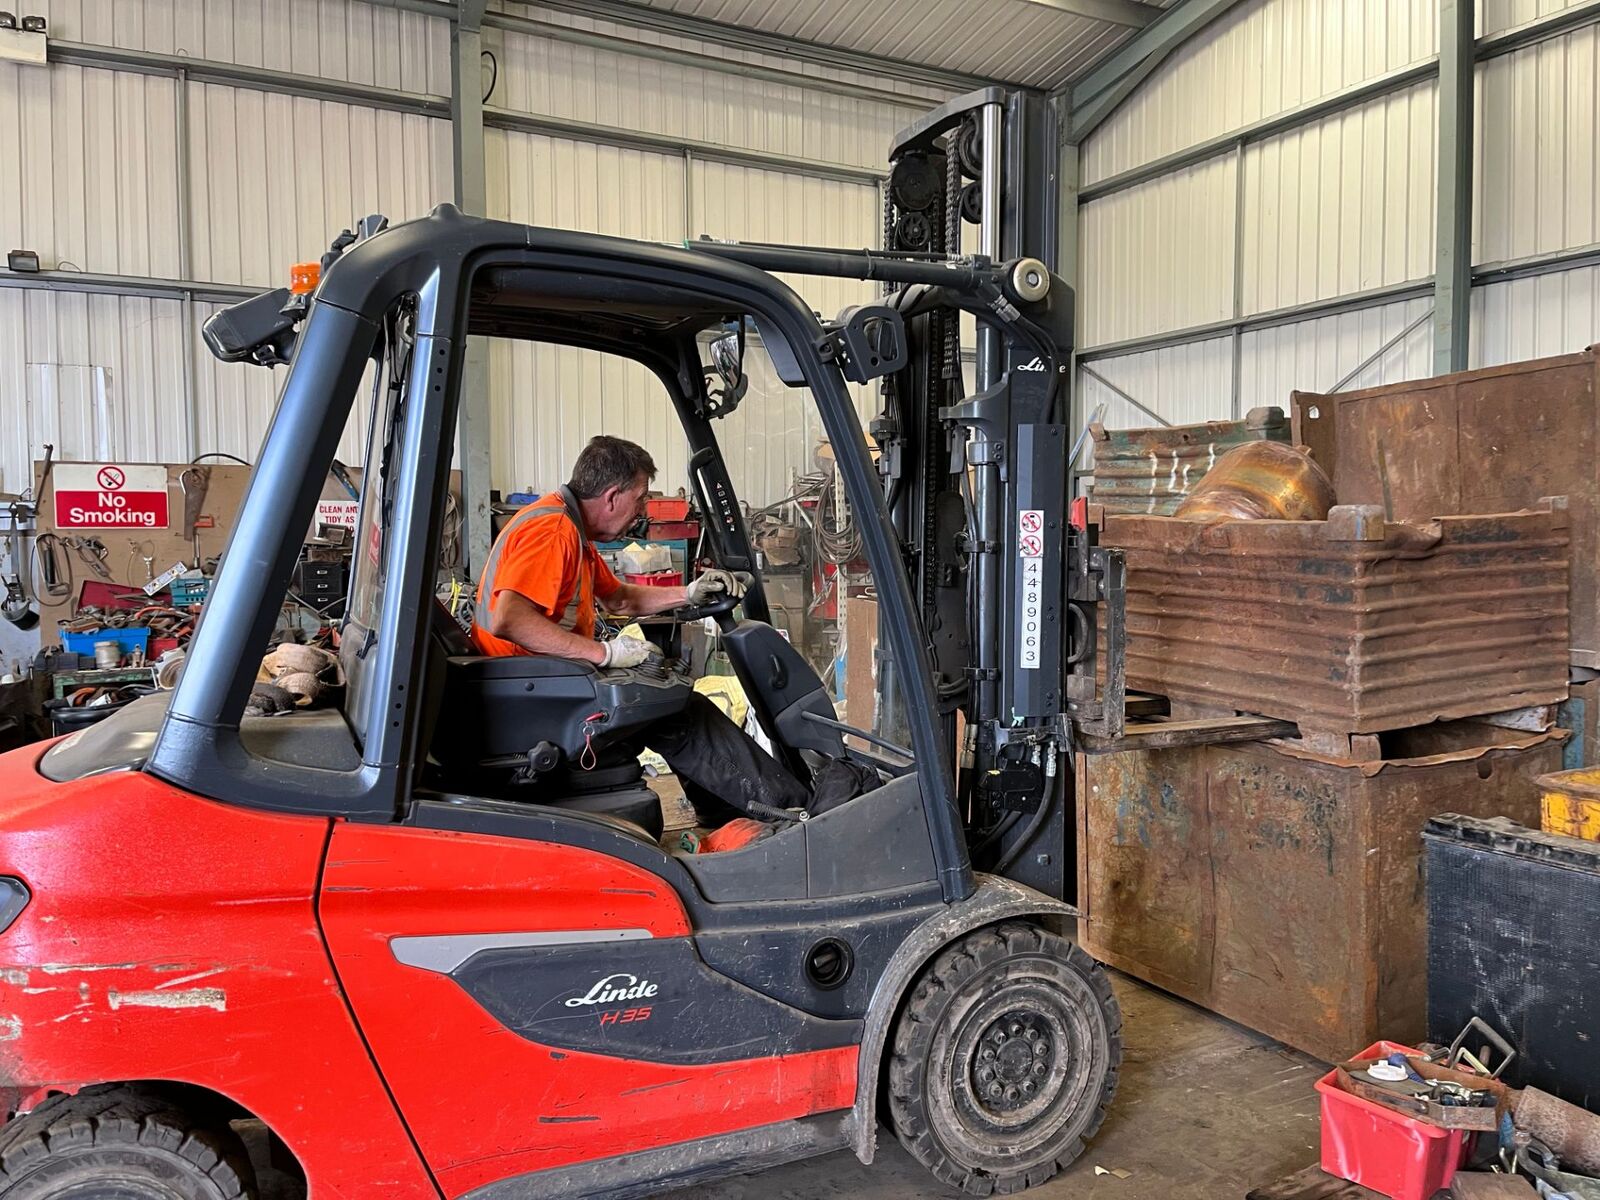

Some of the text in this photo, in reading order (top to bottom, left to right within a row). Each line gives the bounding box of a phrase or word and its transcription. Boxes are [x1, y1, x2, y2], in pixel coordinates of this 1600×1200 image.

[1016, 356, 1066, 373] Lie
[98, 492, 126, 508] No
[69, 507, 156, 526] Smoking
[319, 505, 342, 514] CLEAN
[325, 516, 355, 524] TIDY AS
[1025, 563, 1038, 662] 4489063
[564, 973, 659, 1007] Linde
